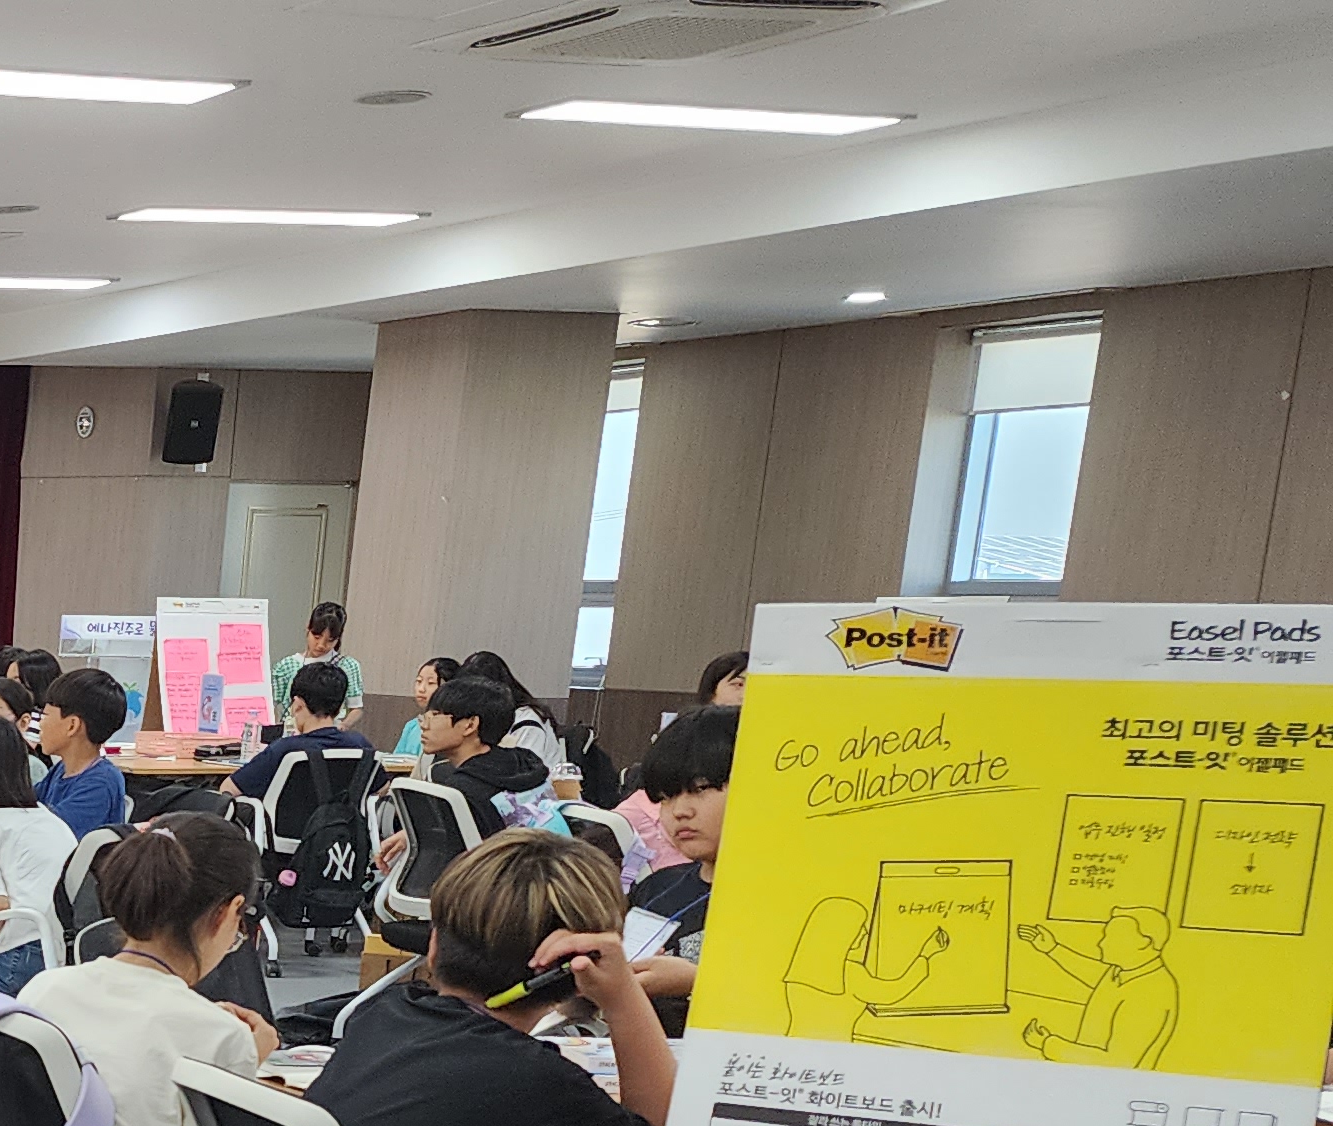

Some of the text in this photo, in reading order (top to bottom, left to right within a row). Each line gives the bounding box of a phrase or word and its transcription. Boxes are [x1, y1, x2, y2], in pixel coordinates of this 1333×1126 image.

[87, 621, 144, 636] 에나진주로
[844, 625, 949, 650] Post-it
[1169, 619, 1322, 643] Easel Pads
[775, 712, 951, 772] Go ahead,
[1101, 717, 1333, 749] 최고의 미팅 솔루션
[806, 749, 1009, 808] Collaborate
[322, 841, 356, 881] NY
[806, 1089, 895, 1114] 화이트보드
